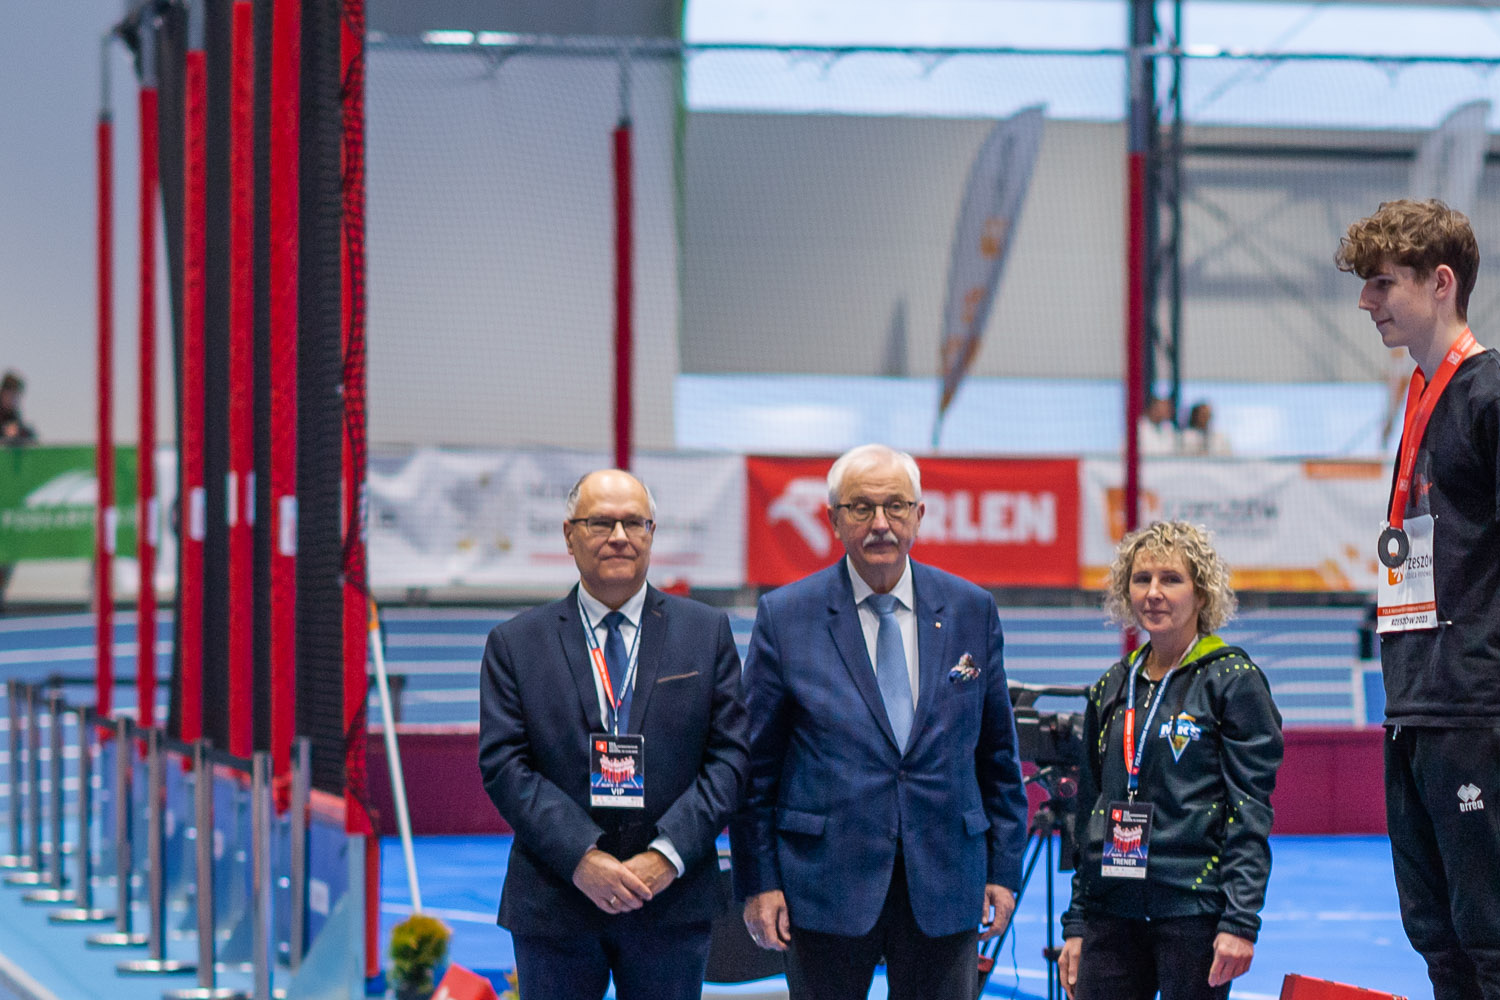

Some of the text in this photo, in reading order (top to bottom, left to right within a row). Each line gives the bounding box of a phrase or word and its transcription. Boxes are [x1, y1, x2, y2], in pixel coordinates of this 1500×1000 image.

[916, 491, 1057, 543] RLEN
[611, 787, 625, 796] VIP
[1112, 857, 1137, 866] TRENER
